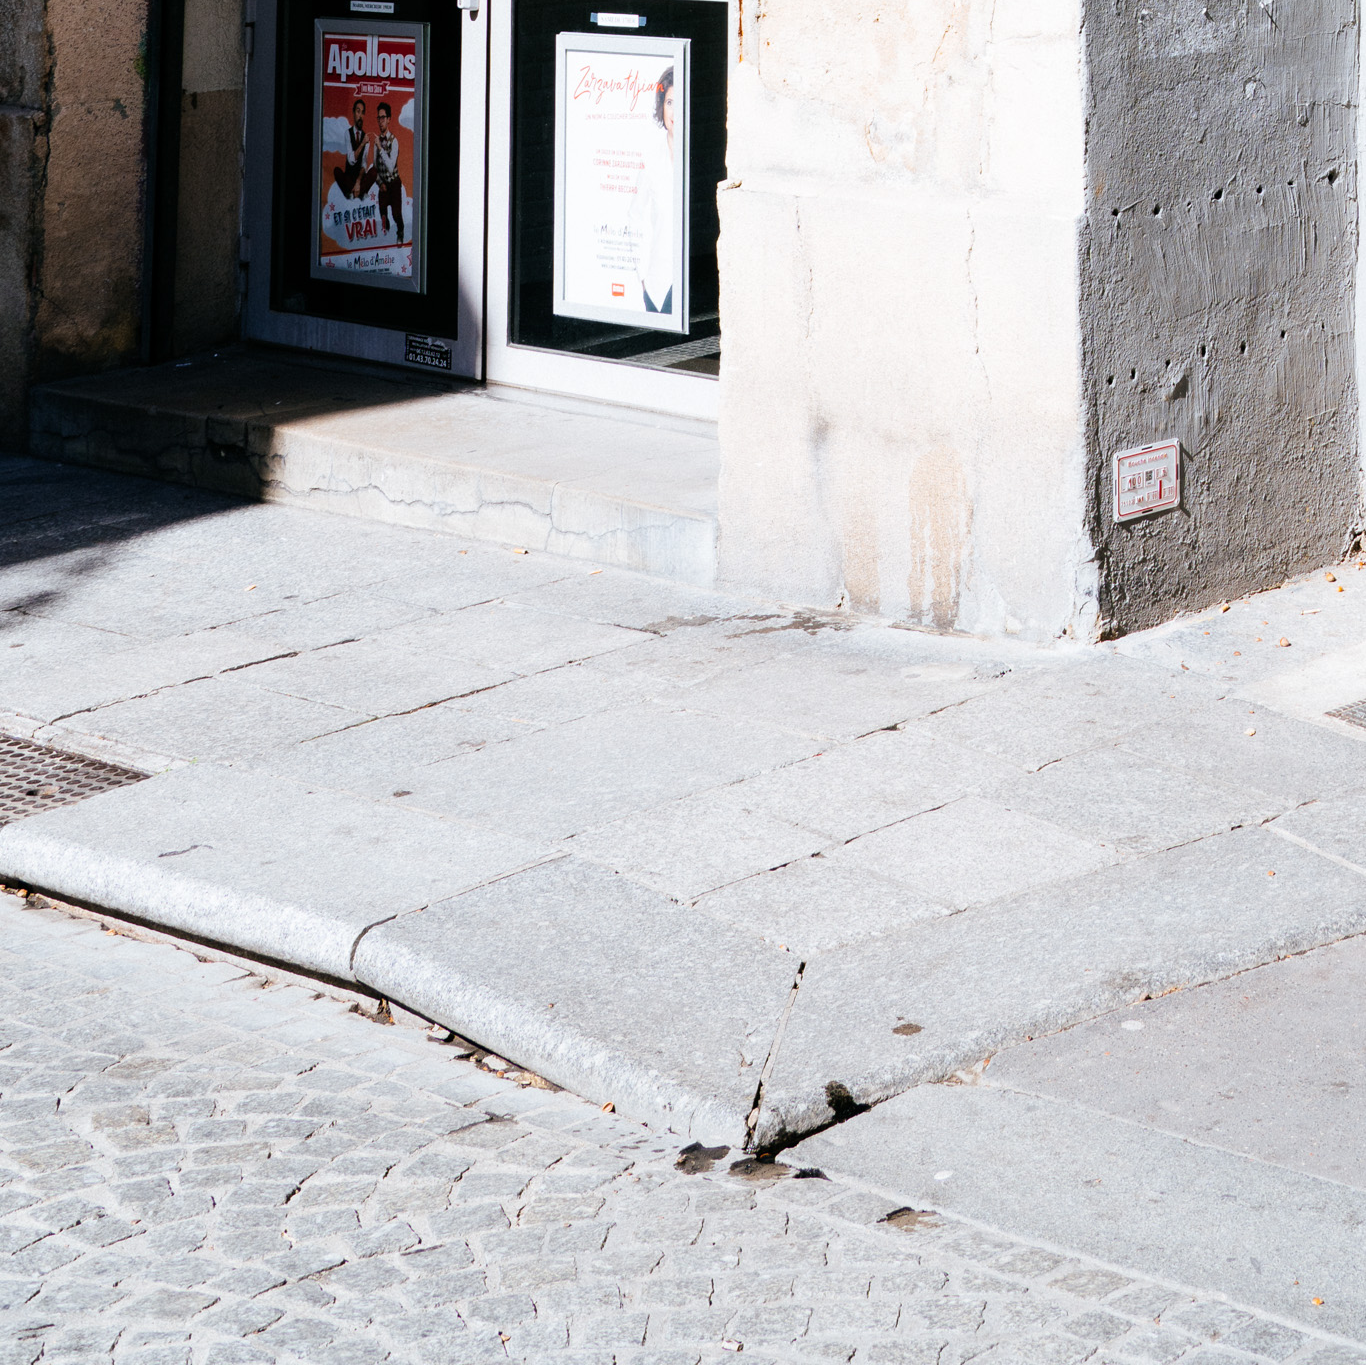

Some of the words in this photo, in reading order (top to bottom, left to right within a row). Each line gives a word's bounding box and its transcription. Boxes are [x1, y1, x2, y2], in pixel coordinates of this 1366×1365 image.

[327, 35, 416, 82] Apollons
[334, 211, 342, 226] ET
[345, 218, 377, 241] VRAI
